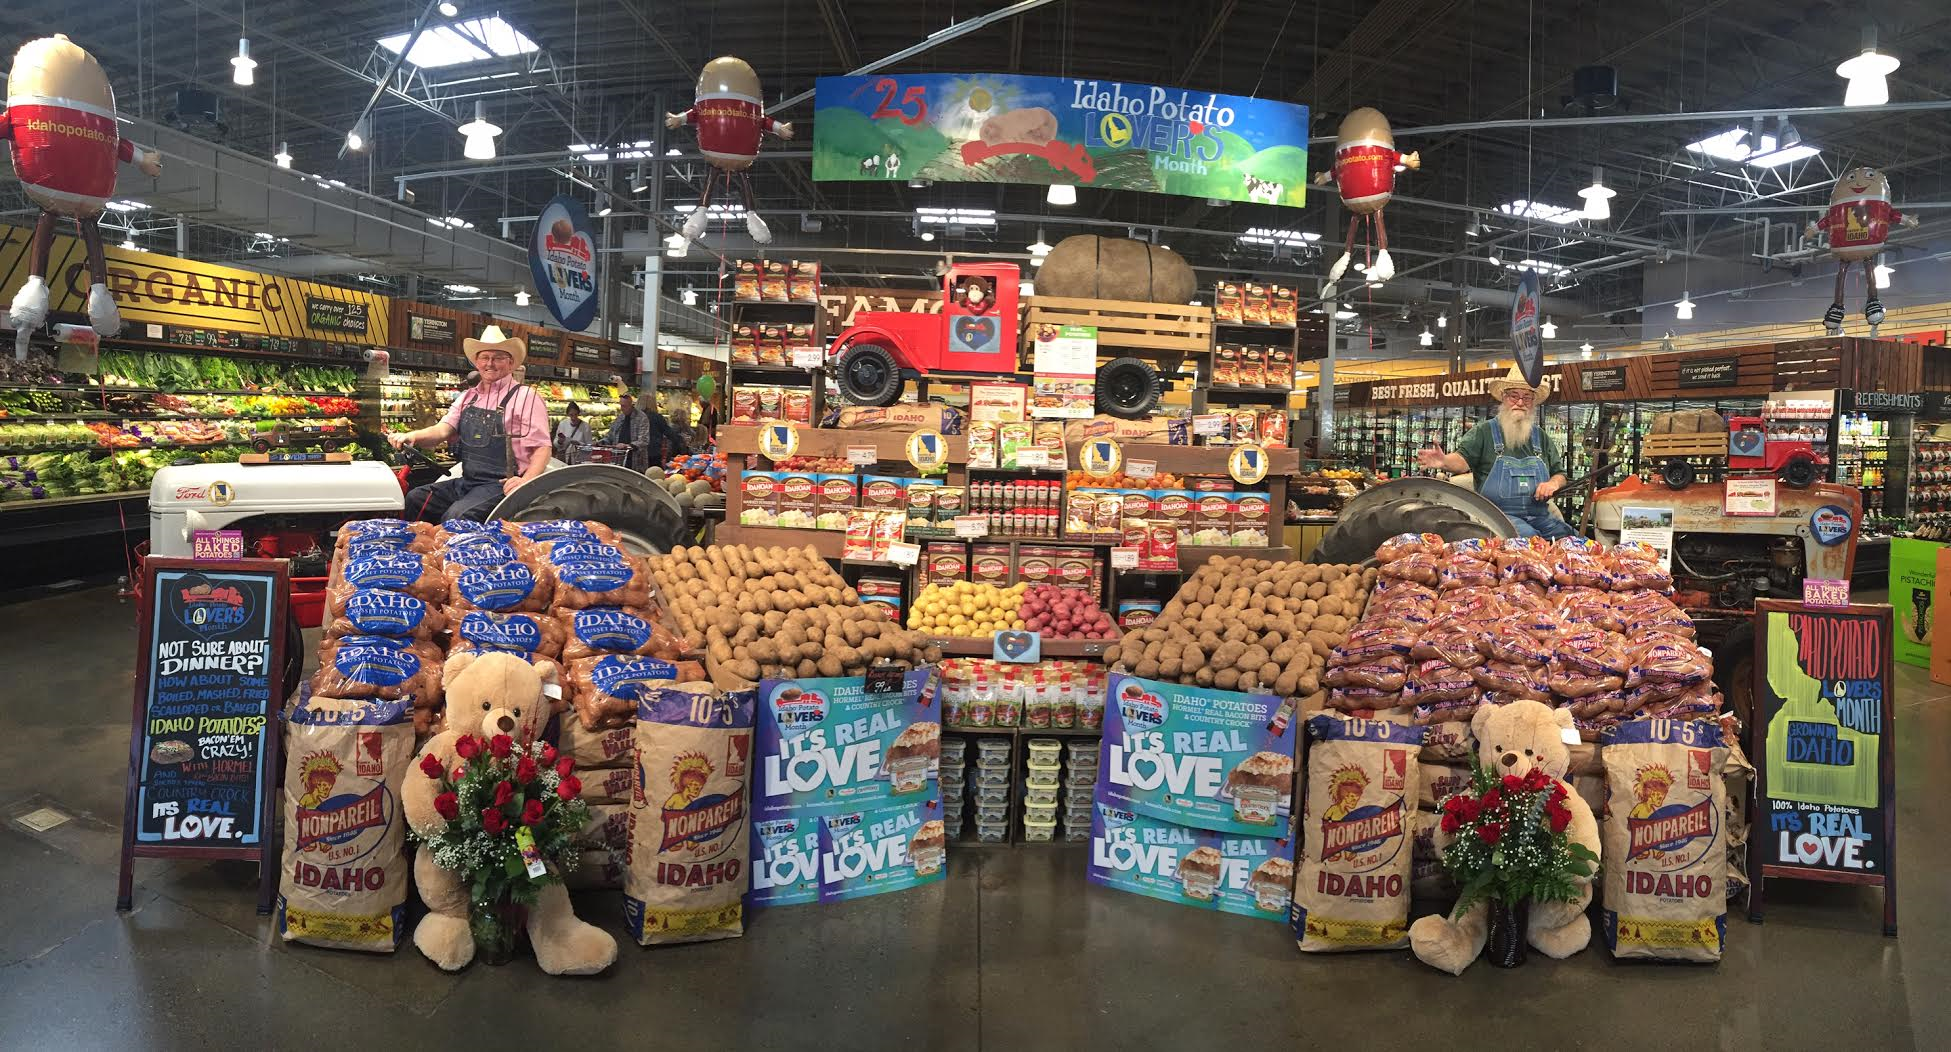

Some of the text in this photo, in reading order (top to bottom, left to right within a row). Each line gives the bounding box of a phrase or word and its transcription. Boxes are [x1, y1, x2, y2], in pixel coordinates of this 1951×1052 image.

[870, 78, 928, 126] 25
[1071, 80, 1236, 127] Idaho Potato
[1154, 154, 1208, 176] Month
[547, 251, 587, 271] Idaho Potato
[65, 262, 284, 313] ORGANIC
[559, 287, 581, 303] Month
[319, 304, 333, 313] carry
[347, 304, 362, 315] 125
[311, 312, 365, 330] ORGANIC choices
[808, 354, 820, 362] 2.99
[1372, 383, 1440, 400] BEST FRESH,
[1856, 392, 1920, 408] REFRESHMENTS
[893, 414, 925, 422] IDAHO
[175, 486, 207, 500] Ford
[747, 483, 773, 491] IDAHOAN
[784, 484, 812, 492] IDAHOAN
[823, 486, 852, 495] IDAHOAN
[868, 488, 897, 496] IDAHOAN
[1161, 502, 1188, 511] IDAHOAN
[1200, 503, 1228, 512] IDAHOAN
[1239, 504, 1265, 513] IDAHOAN
[195, 544, 240, 552] BAKED
[195, 551, 233, 559] POTATOES
[553, 544, 617, 558] IDAHO
[351, 560, 419, 574] IDAHO
[380, 568, 415, 576] POTATOES
[936, 563, 961, 572] IDAHOAN
[978, 565, 1004, 573] IDAHOAN
[1024, 566, 1049, 575] IDAHOAN
[463, 568, 531, 586] IDAHO
[493, 580, 529, 588] POTATOES
[349, 595, 421, 609] IDAHO
[1805, 590, 1848, 600] BAKED
[379, 608, 416, 617] POTATOES
[200, 623, 228, 632] Month
[462, 620, 536, 636] IDAHO
[577, 612, 647, 630] IDAHO
[582, 627, 609, 635] RUSSET
[159, 640, 269, 659] NOT SURE ABOUT
[340, 646, 415, 663] IDAHO
[1790, 613, 1880, 681] IDAHO POTATO
[160, 655, 263, 676] DINNER?
[376, 656, 411, 668] POTATOES
[597, 661, 671, 680] IDAHO
[632, 669, 670, 679] POTATOES
[158, 675, 269, 690] HOW ABOUT SOME
[1823, 680, 1882, 698] LOVERS
[243, 687, 270, 700] FRIED
[903, 689, 918, 697] BITS
[151, 703, 209, 718] SCALLOPED
[223, 701, 259, 714] BAKED
[778, 704, 820, 712] Idaho Potato
[1122, 701, 1159, 713] Idaho Potato
[1173, 693, 1268, 714] IDAHO POTATOES
[1172, 703, 1267, 722] HORMEL REAL BACON BITS
[1837, 698, 1881, 734] MONTH
[150, 715, 267, 735] IDAHO POTATOES?
[784, 723, 808, 731] Month
[1127, 719, 1147, 729] Month
[1189, 714, 1251, 728] COUNTRY CROCK
[779, 708, 902, 761] IT'S REAL
[1788, 722, 1838, 740] GROWN IN
[1123, 729, 1248, 754] IT'S REAL
[201, 742, 253, 760] CRAZY!
[1786, 736, 1851, 766] IDAHO
[154, 770, 177, 778] AND
[182, 760, 252, 773] WITH HORMEL
[358, 763, 381, 774] IDAHO
[764, 738, 881, 798] LOVE
[1109, 744, 1223, 798] LOVE
[1384, 777, 1405, 789] IDAHO
[1688, 776, 1711, 788] IDAHO
[211, 787, 250, 801] CROCK
[187, 798, 238, 816] REAL
[1772, 800, 1860, 815] 100% Idaho Potatoes
[301, 799, 380, 838] NONPAREIL
[667, 797, 741, 839] NONPAREIL
[164, 815, 243, 840] LOVE.
[832, 810, 921, 856] IT'S REAL
[1327, 815, 1399, 850] NONPAREIL
[1633, 815, 1707, 847] NONPAREIL
[1808, 812, 1872, 841] REAL
[624, 811, 637, 867] IDAHO
[1104, 827, 1196, 845] IT'S REAL
[328, 850, 342, 862] U.S.
[694, 848, 705, 858] U.S.
[763, 838, 800, 863] IT'S
[1093, 837, 1178, 878] LOVE
[1779, 830, 1875, 869] LOVE.
[822, 833, 907, 885] LOVE
[1352, 858, 1364, 869] U.S.
[1661, 857, 1674, 868] U.S.
[293, 860, 385, 893] IDAHO
[657, 858, 741, 888] IDAHO
[1317, 870, 1403, 899] IDAHO
[1626, 870, 1712, 898] IDAHO
